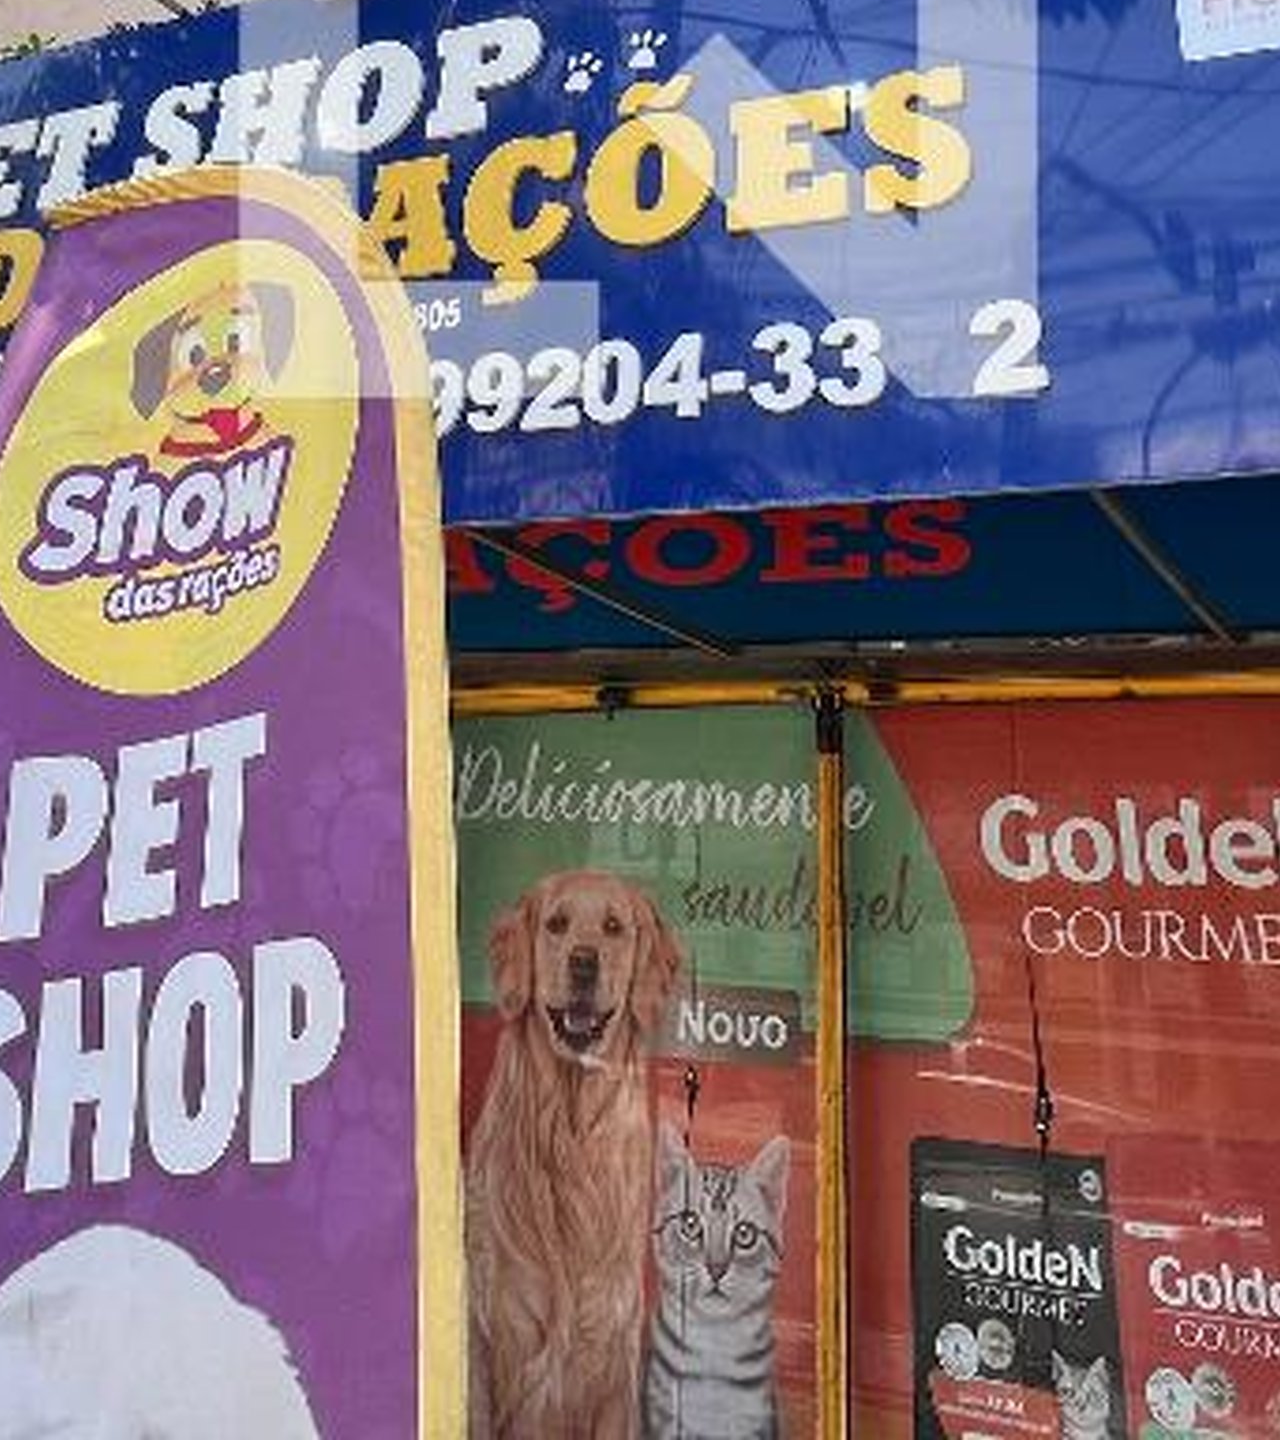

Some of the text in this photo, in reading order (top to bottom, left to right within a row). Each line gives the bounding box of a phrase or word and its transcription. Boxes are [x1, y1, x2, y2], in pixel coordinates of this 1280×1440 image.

[132, 16, 545, 167] SHOP
[360, 60, 973, 306] AÇÕES
[24, 444, 288, 575] Show
[105, 547, 280, 619] das rações
[456, 740, 876, 830] Deliciosamene
[680, 853, 922, 935] saudel
[943, 1224, 1103, 1291] GoldeN
[965, 1281, 1088, 1326] GOURMET
